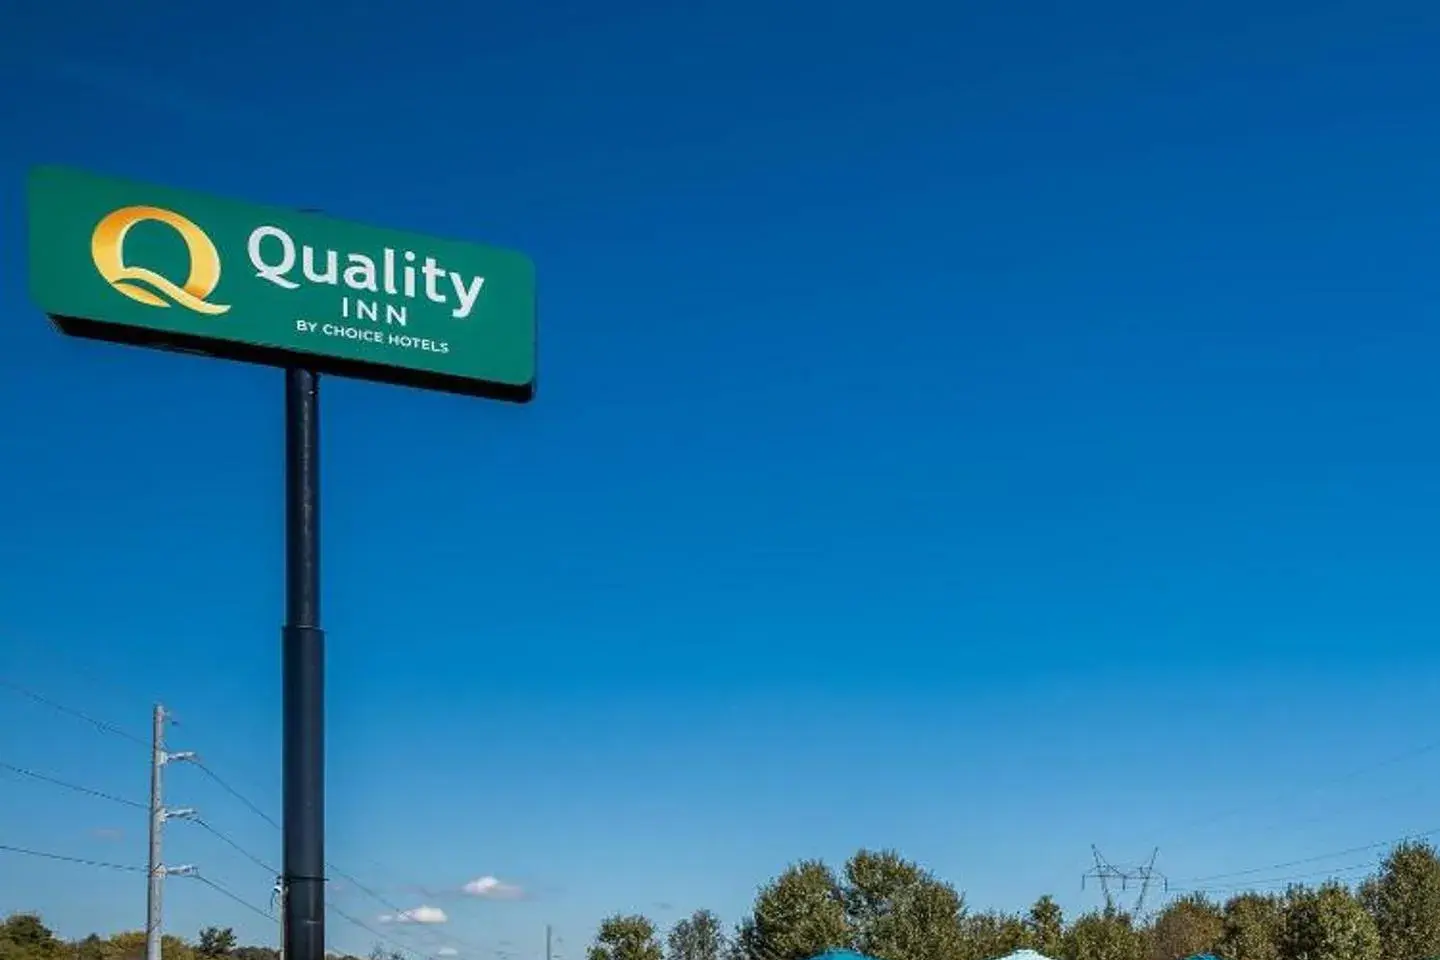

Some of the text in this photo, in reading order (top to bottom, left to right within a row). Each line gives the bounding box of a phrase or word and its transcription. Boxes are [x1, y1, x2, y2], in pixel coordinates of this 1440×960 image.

[247, 226, 485, 318] Quality
[342, 297, 408, 326] INN
[296, 320, 450, 354] BY CHOICE HOTELS
